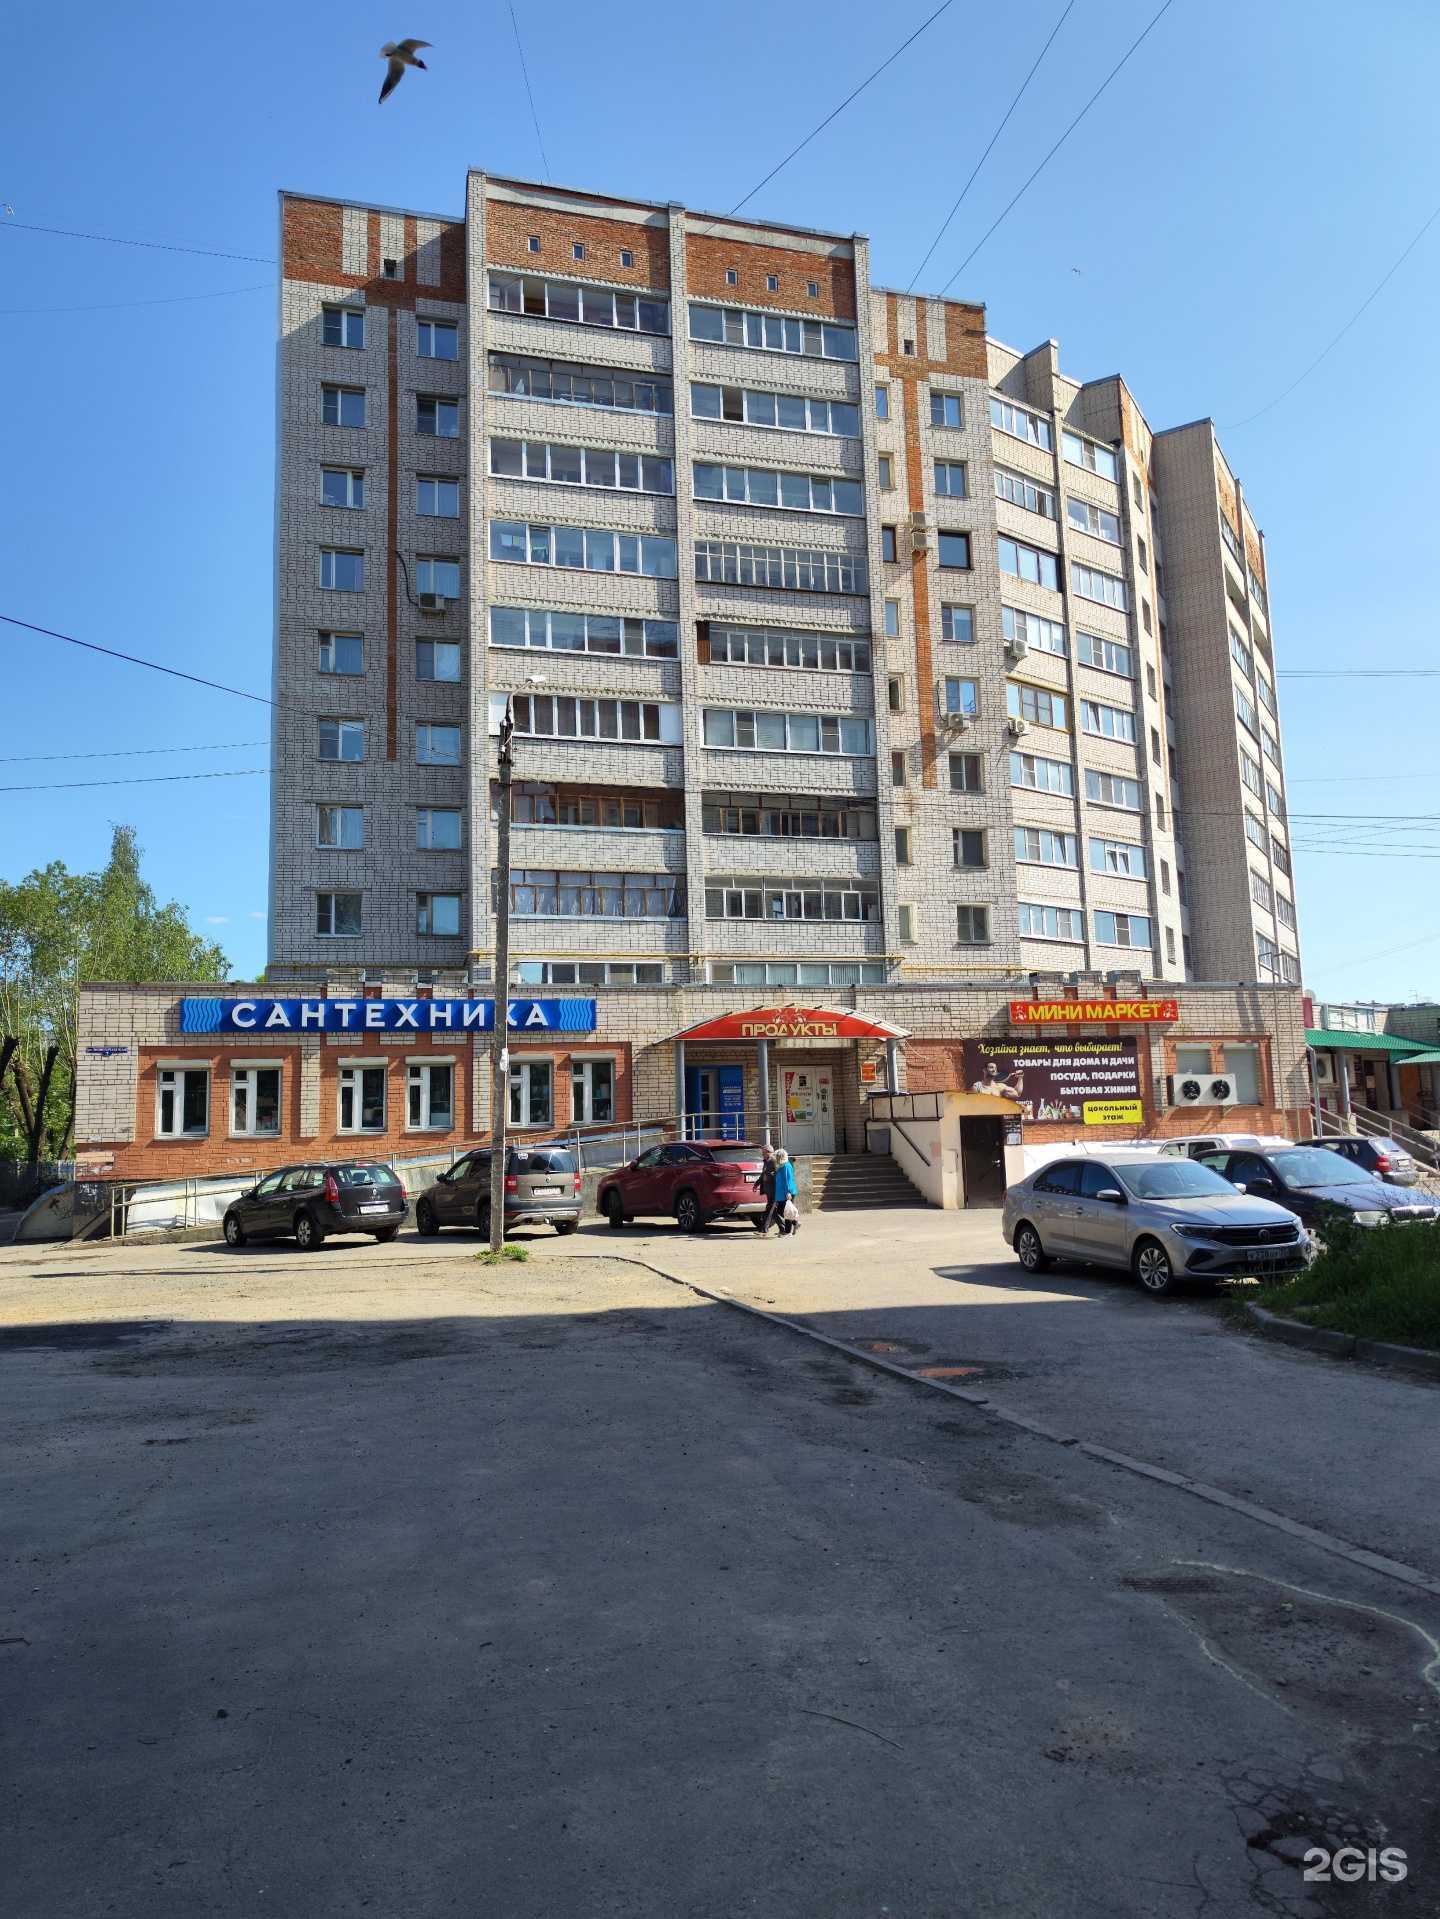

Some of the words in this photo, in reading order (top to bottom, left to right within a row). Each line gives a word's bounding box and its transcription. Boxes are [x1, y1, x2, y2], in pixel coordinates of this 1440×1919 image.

[1028, 1005, 1082, 1020] МИНИ
[1085, 1003, 1161, 1019] МАРКЕТ
[741, 1023, 837, 1036] ПРОДУКТЫ
[977, 1043, 1017, 1056] Хозяйка
[1019, 1045, 1050, 1056] знает,
[1054, 1045, 1073, 1053] что
[1074, 1042, 1123, 1055] выбирает!
[1013, 1058, 1051, 1067] ТОВАРЫ
[1053, 1058, 1072, 1068] ДЛЯ
[1073, 1057, 1100, 1067] ДОМА
[1101, 1057, 1108, 1065] И
[1109, 1056, 1135, 1066] ДАЧИ
[1050, 1072, 1090, 1081] ПОСУДА,
[1091, 1071, 1136, 1080] ПОДАРКИ
[1060, 1086, 1103, 1095] БЫТОВАЯ
[1104, 1085, 1137, 1094] ХИМИЯ
